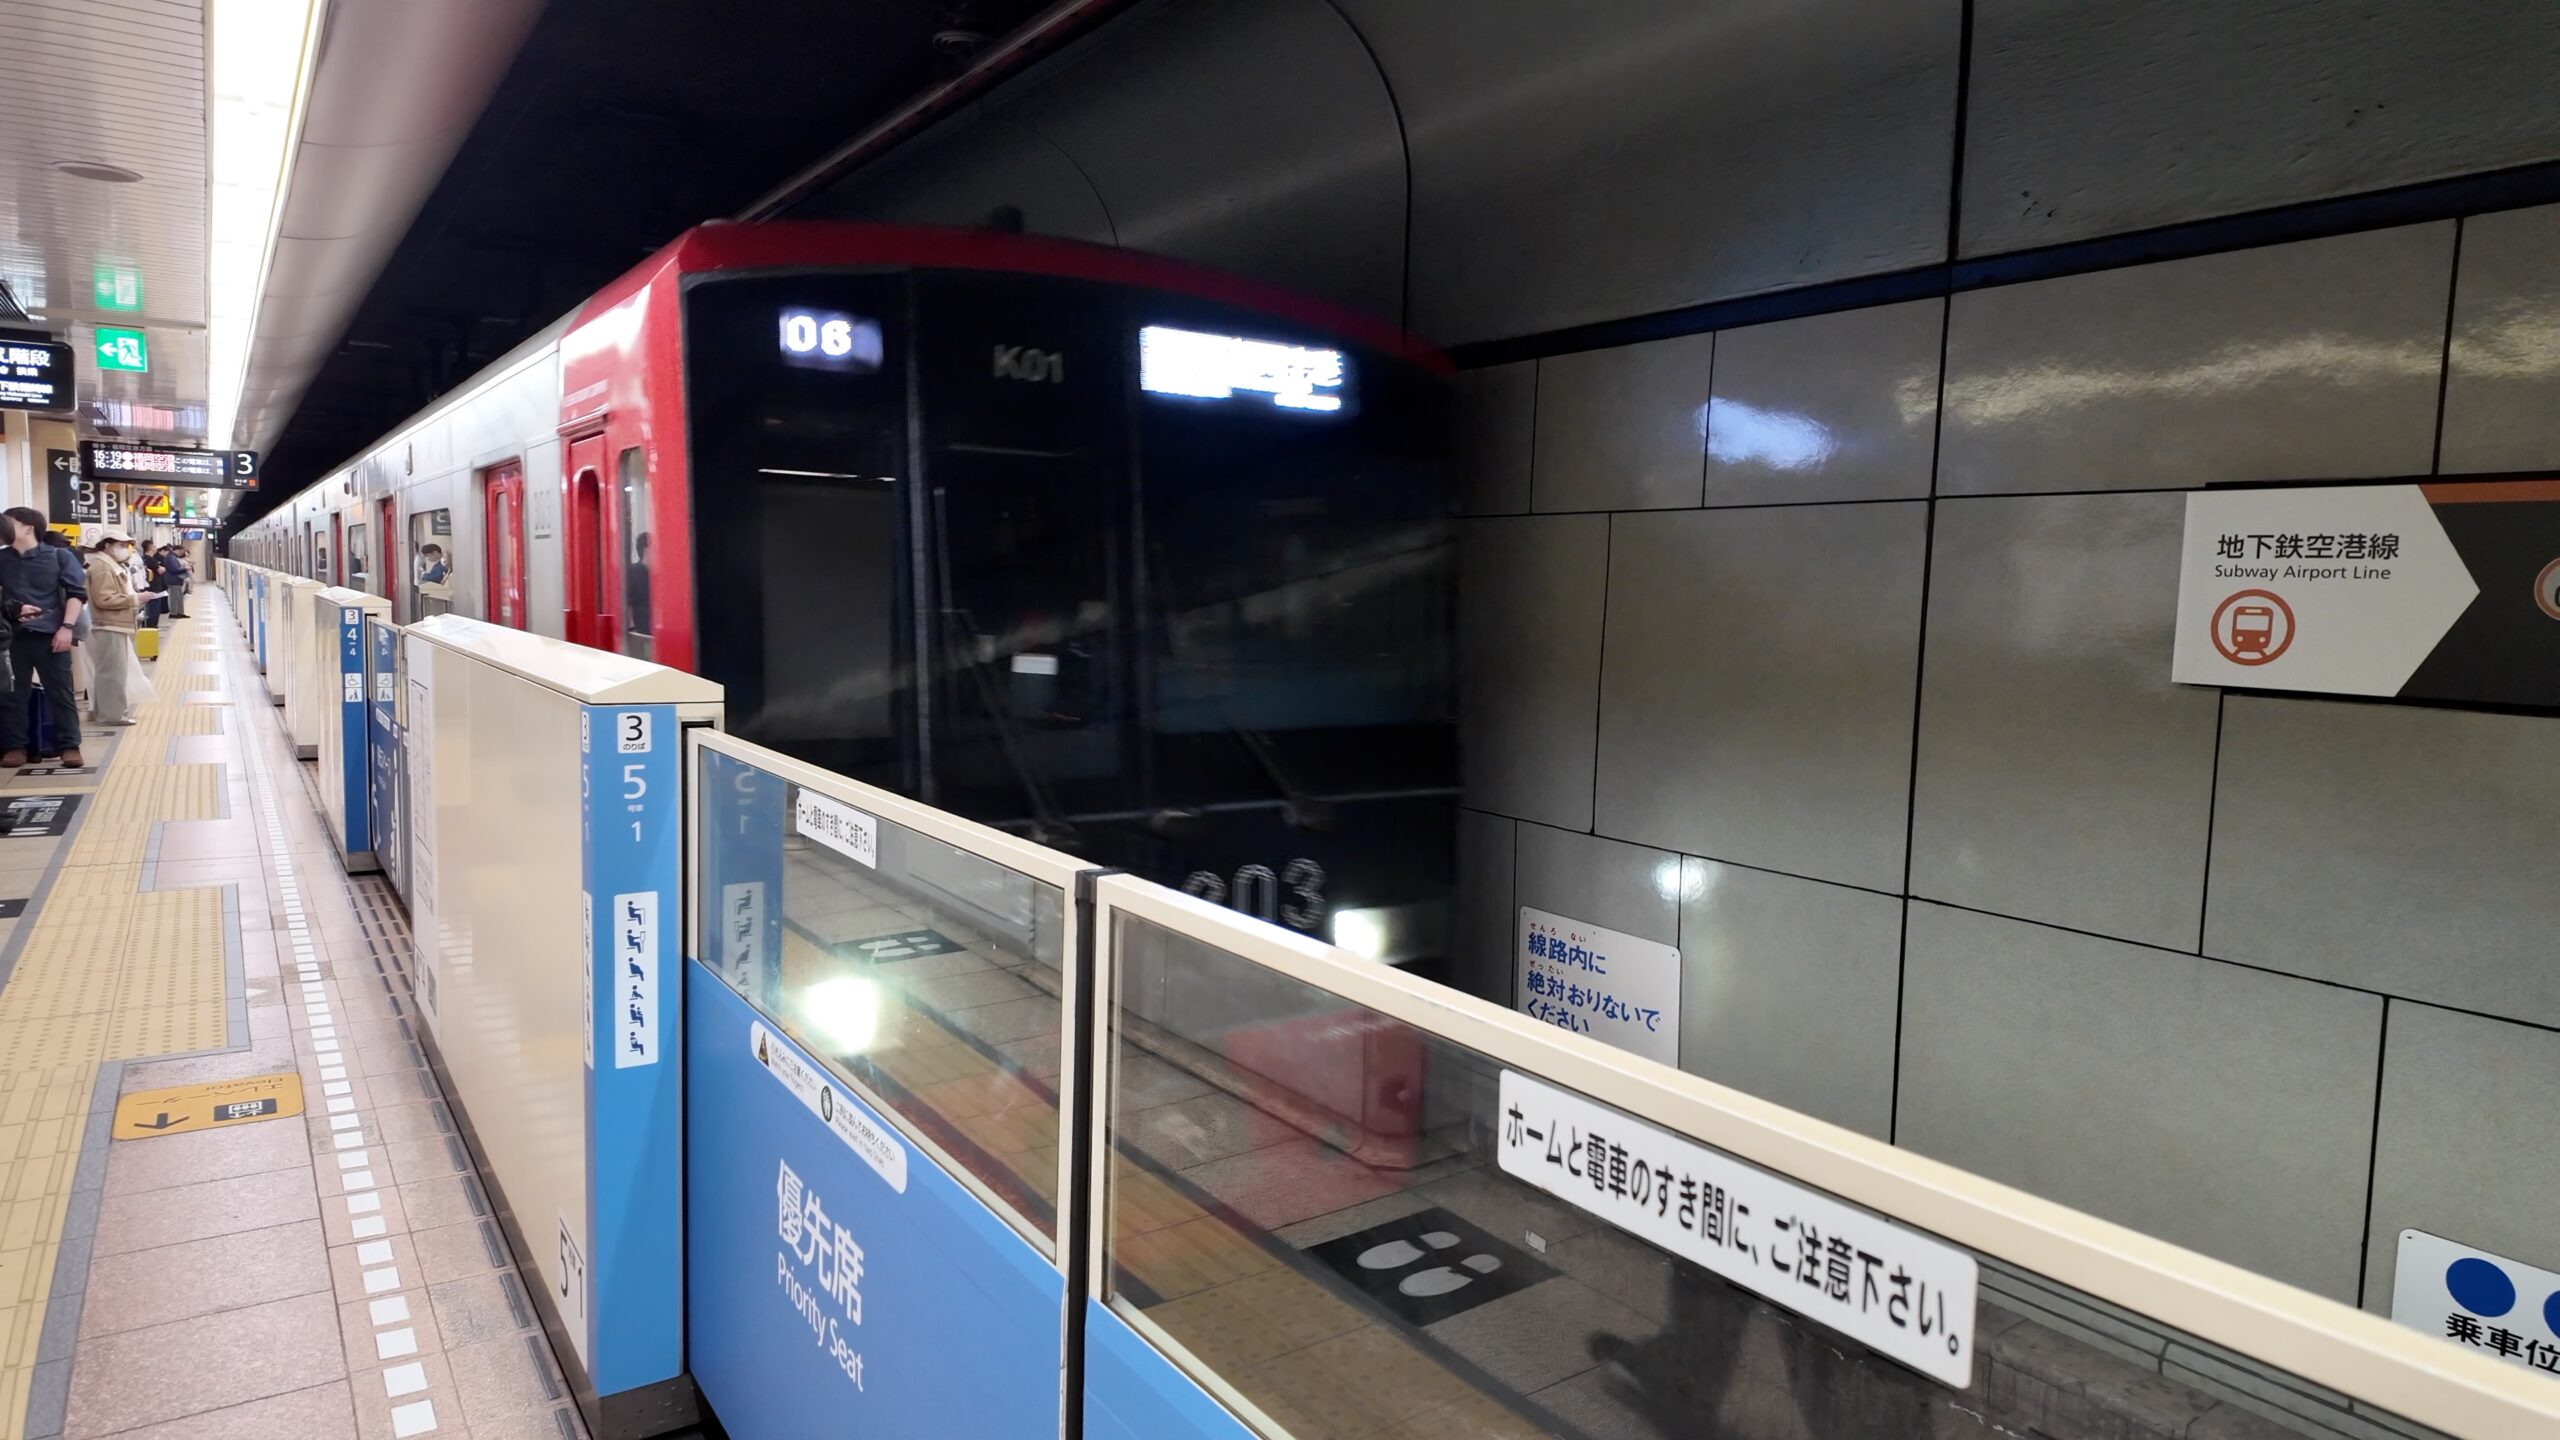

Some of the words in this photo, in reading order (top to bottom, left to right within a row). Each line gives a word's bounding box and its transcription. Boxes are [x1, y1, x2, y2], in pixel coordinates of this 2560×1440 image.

[993, 344, 1063, 383] K01
[237, 453, 253, 475] 3
[2216, 533, 2400, 560] 地下鉄空港線
[2215, 564, 2278, 581] Subway
[2283, 565, 2347, 581] Airport
[2353, 566, 2391, 579] Line
[347, 627, 358, 641] 4
[626, 715, 644, 742] 3
[623, 742, 646, 751] のりば
[623, 764, 648, 800] 5
[631, 821, 642, 843] 1
[1530, 922, 1557, 936] せんろ
[1570, 932, 1587, 943] ない
[1528, 932, 1607, 975] 線路内に
[1529, 960, 1564, 976] ぜったい
[1527, 970, 1661, 1032] 絶対おりないで
[1527, 998, 1590, 1033] ください
[776, 1158, 864, 1326] 優先席
[1506, 1102, 1960, 1356] ホームと電車のすき間に、ご注意下さい。
[778, 1251, 826, 1347] Priority
[830, 1317, 864, 1393] Seat
[2446, 1312, 2560, 1375] 乗車位
